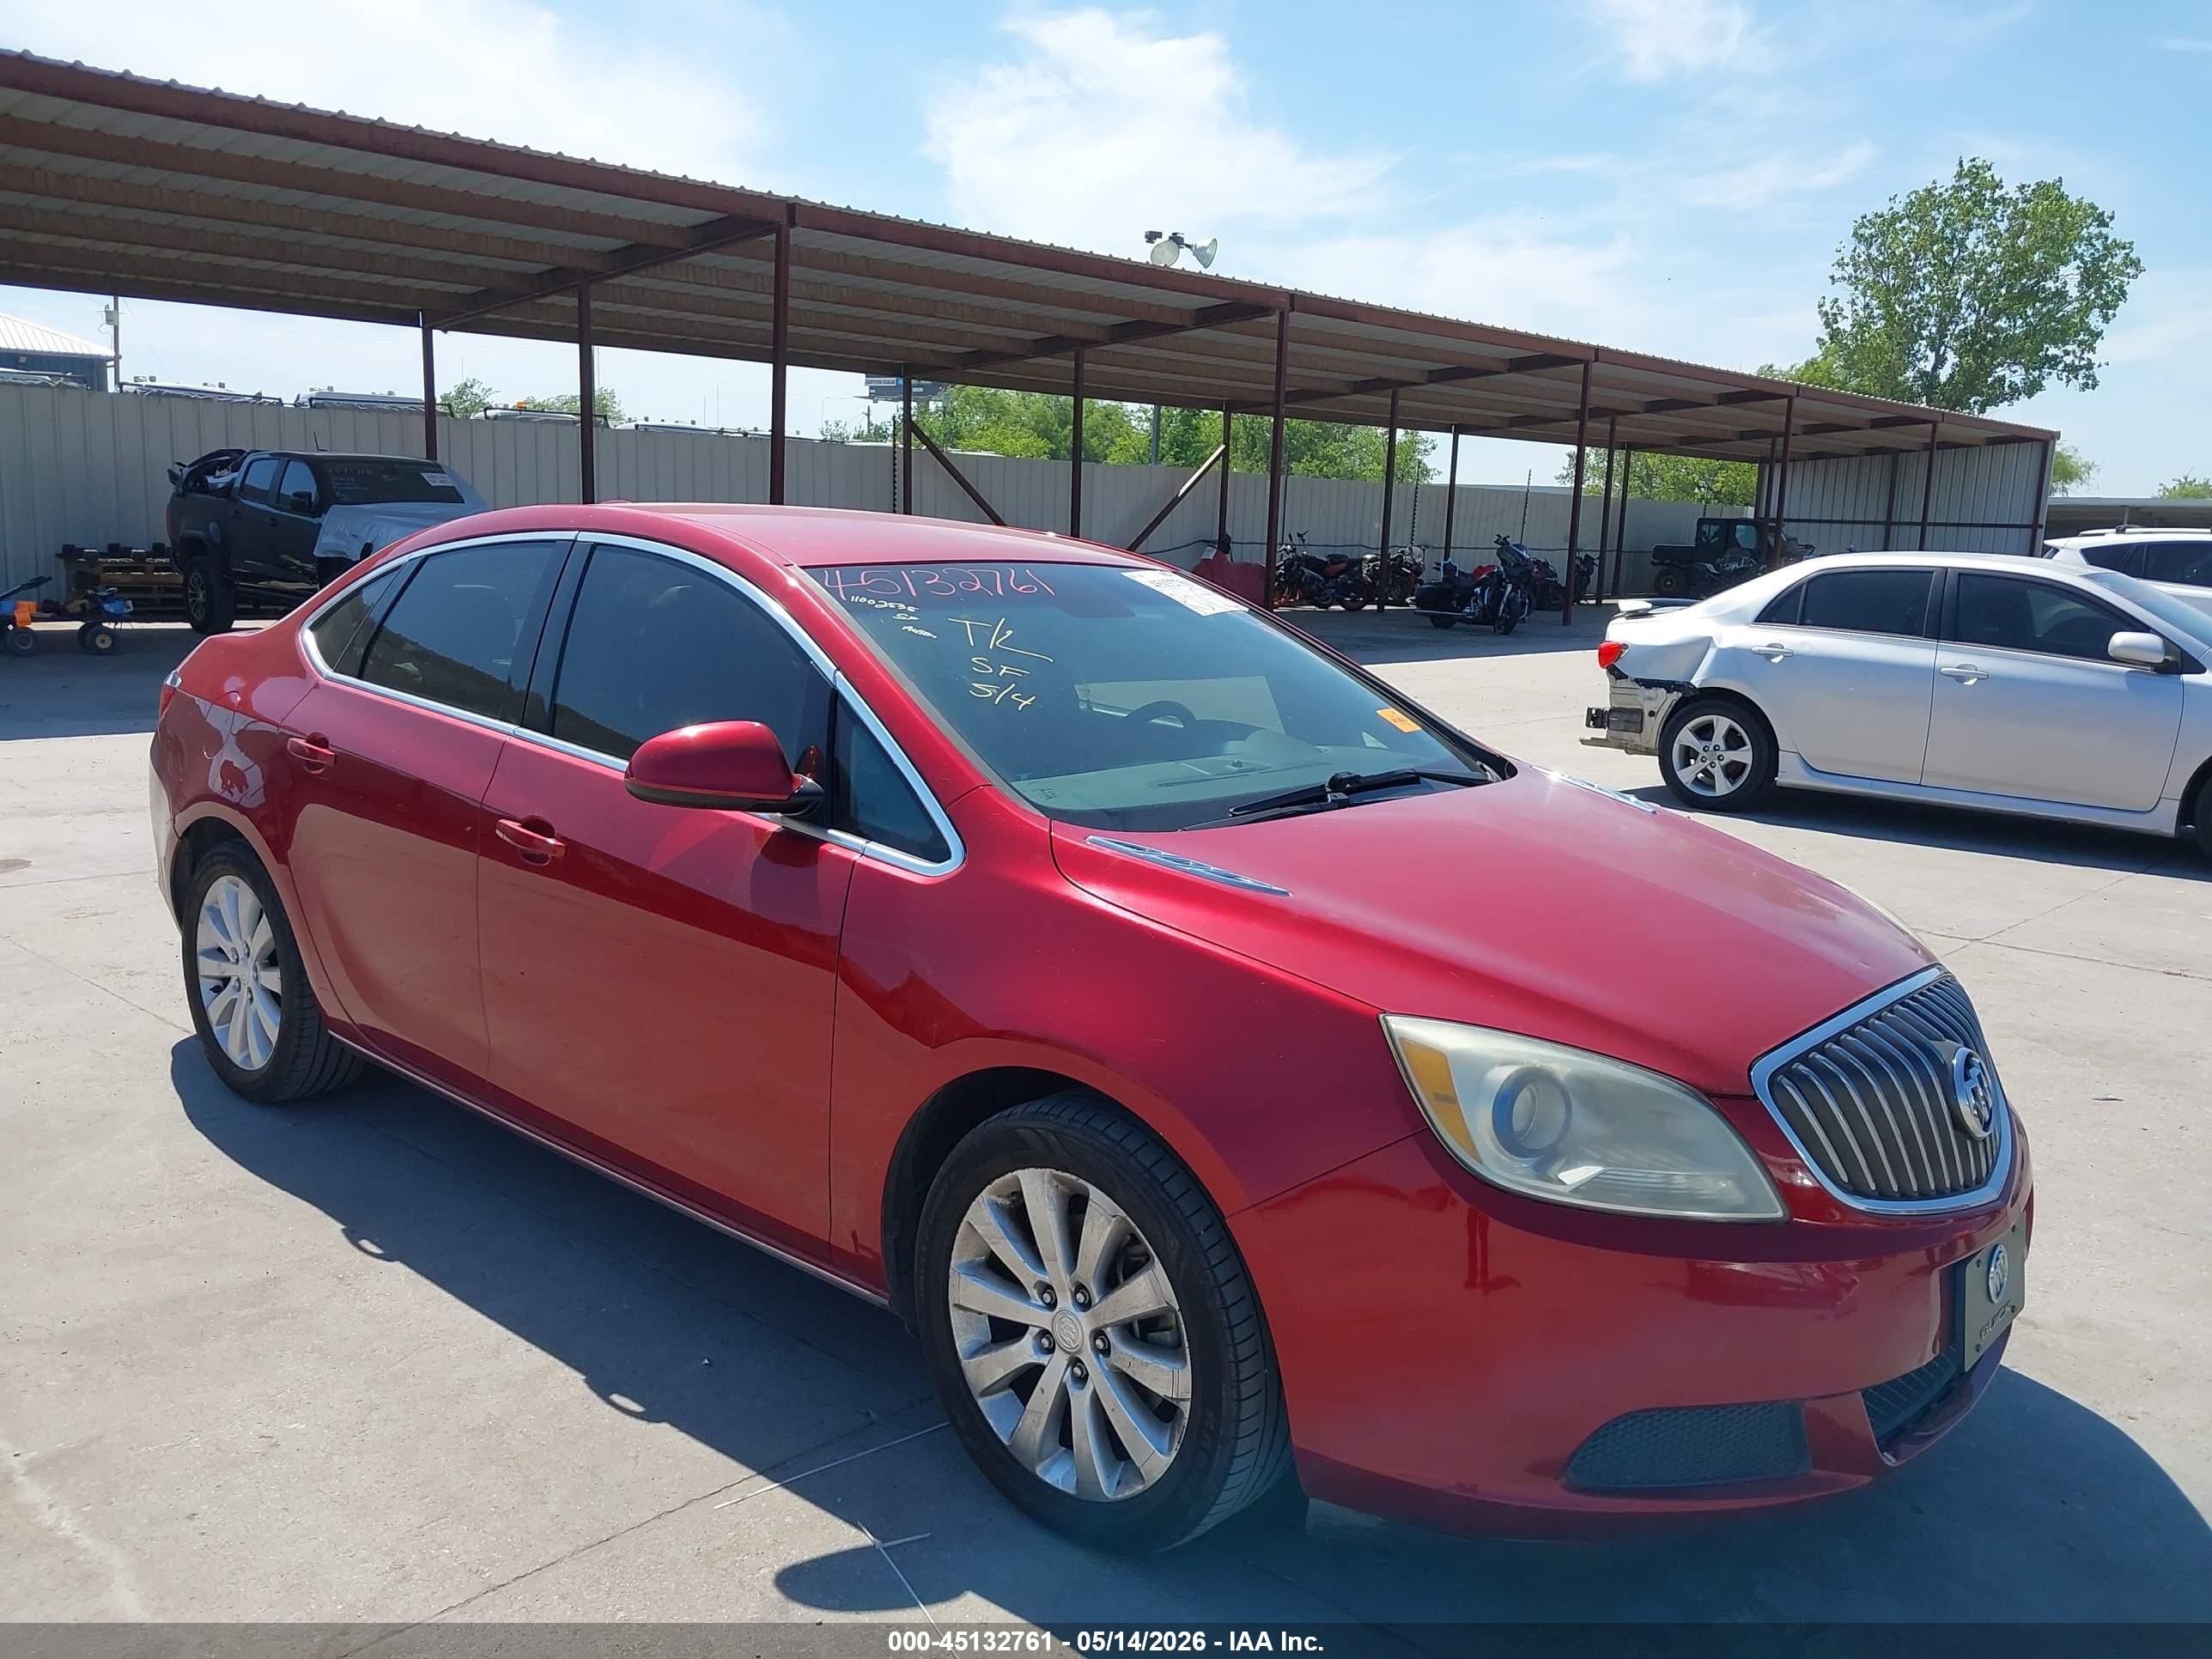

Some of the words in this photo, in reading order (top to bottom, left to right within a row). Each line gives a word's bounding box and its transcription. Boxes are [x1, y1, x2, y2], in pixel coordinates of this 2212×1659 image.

[823, 568, 1055, 601] 45132761
[970, 656, 1031, 678] SF
[969, 683, 1036, 712] 5/4
[1979, 1299, 2011, 1340] BUICK
